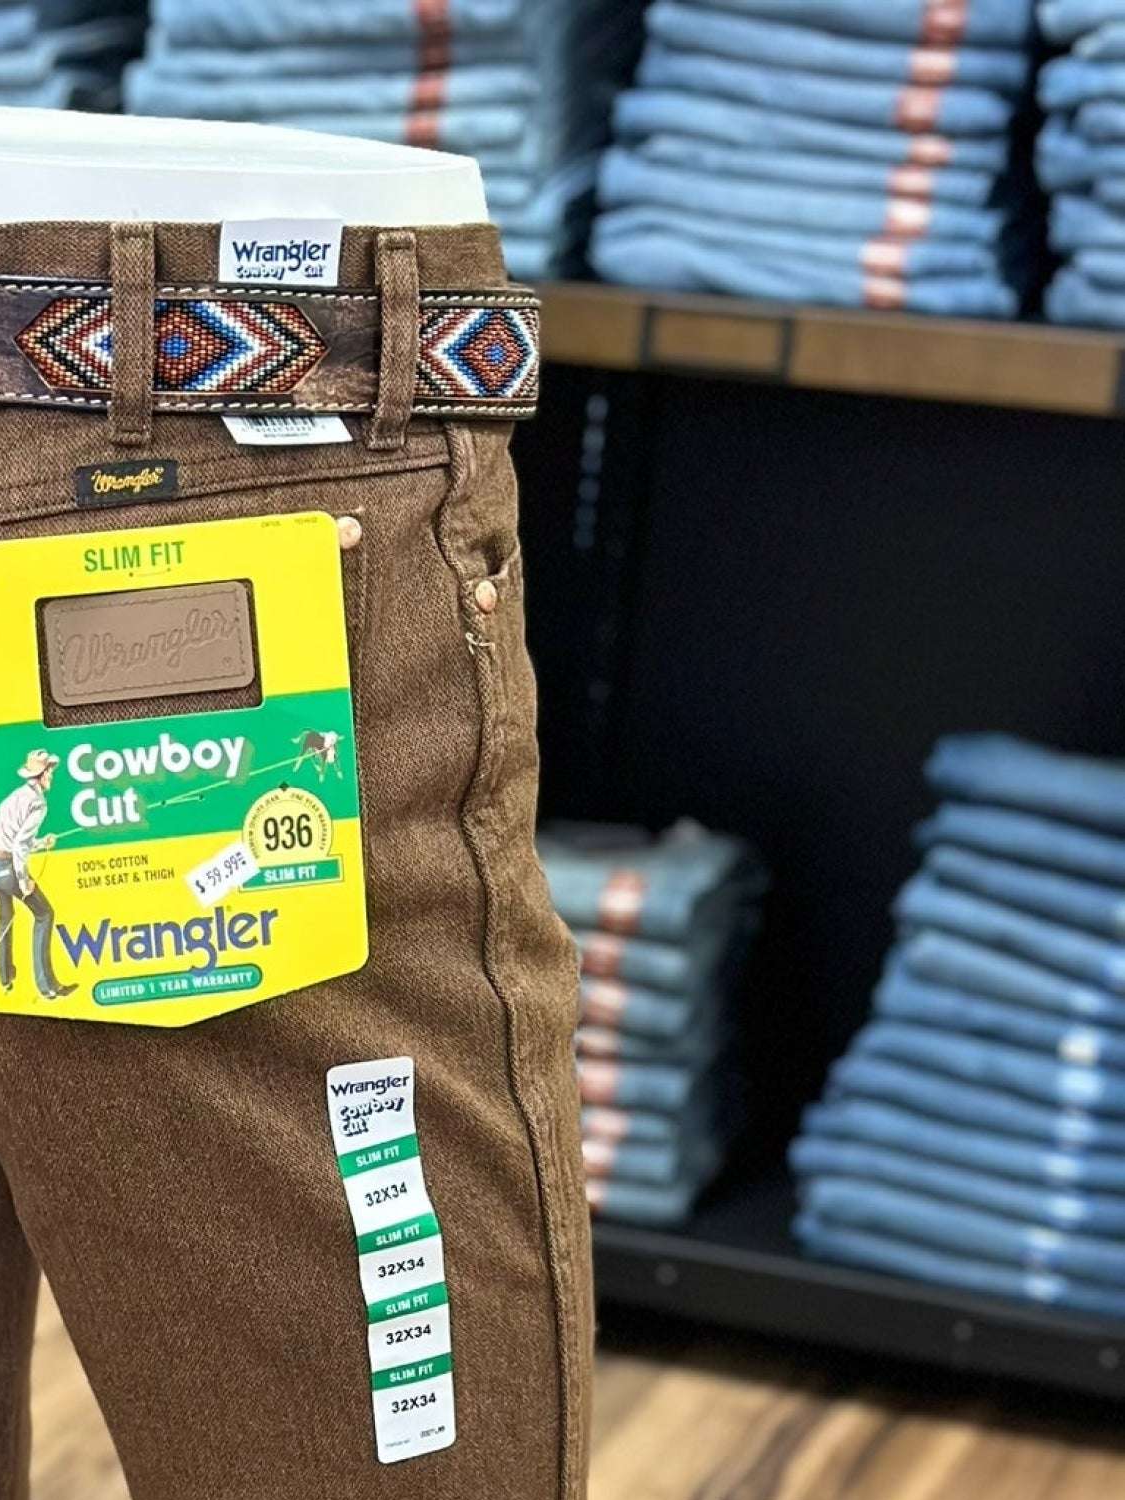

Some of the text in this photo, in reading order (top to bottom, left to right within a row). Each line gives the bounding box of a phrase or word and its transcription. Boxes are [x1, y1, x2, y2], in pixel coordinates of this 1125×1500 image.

[232, 240, 332, 271] Wrangler
[235, 264, 325, 280] Cowboy Cut
[91, 467, 158, 493] Wrangler
[83, 540, 186, 573] SLIM FIT
[62, 607, 237, 685] Wrangler
[67, 732, 246, 783] Cowboy
[71, 791, 142, 829] Cut
[263, 813, 313, 852] 936
[77, 854, 149, 873] 100% COTTON
[263, 865, 317, 883] SLIM FIT
[77, 867, 175, 889] SLIM SEAT & THIGH
[56, 907, 279, 974] Wrangler
[100, 971, 253, 999] LIMITED 1 YEAR WARRANTY
[330, 1076, 410, 1097] Wrangler
[340, 1097, 405, 1119] Cowboy
[342, 1118, 369, 1137] Cut
[356, 1145, 400, 1167] SLIM FIT
[364, 1181, 408, 1207] 32X34
[376, 1223, 420, 1246] SLIM FIT
[378, 1257, 425, 1278] 32X34
[386, 1293, 428, 1315] SLIM FIT
[386, 1324, 431, 1345] 32X34
[389, 1363, 433, 1382] SLIM FIT
[391, 1392, 436, 1414] 32X34
